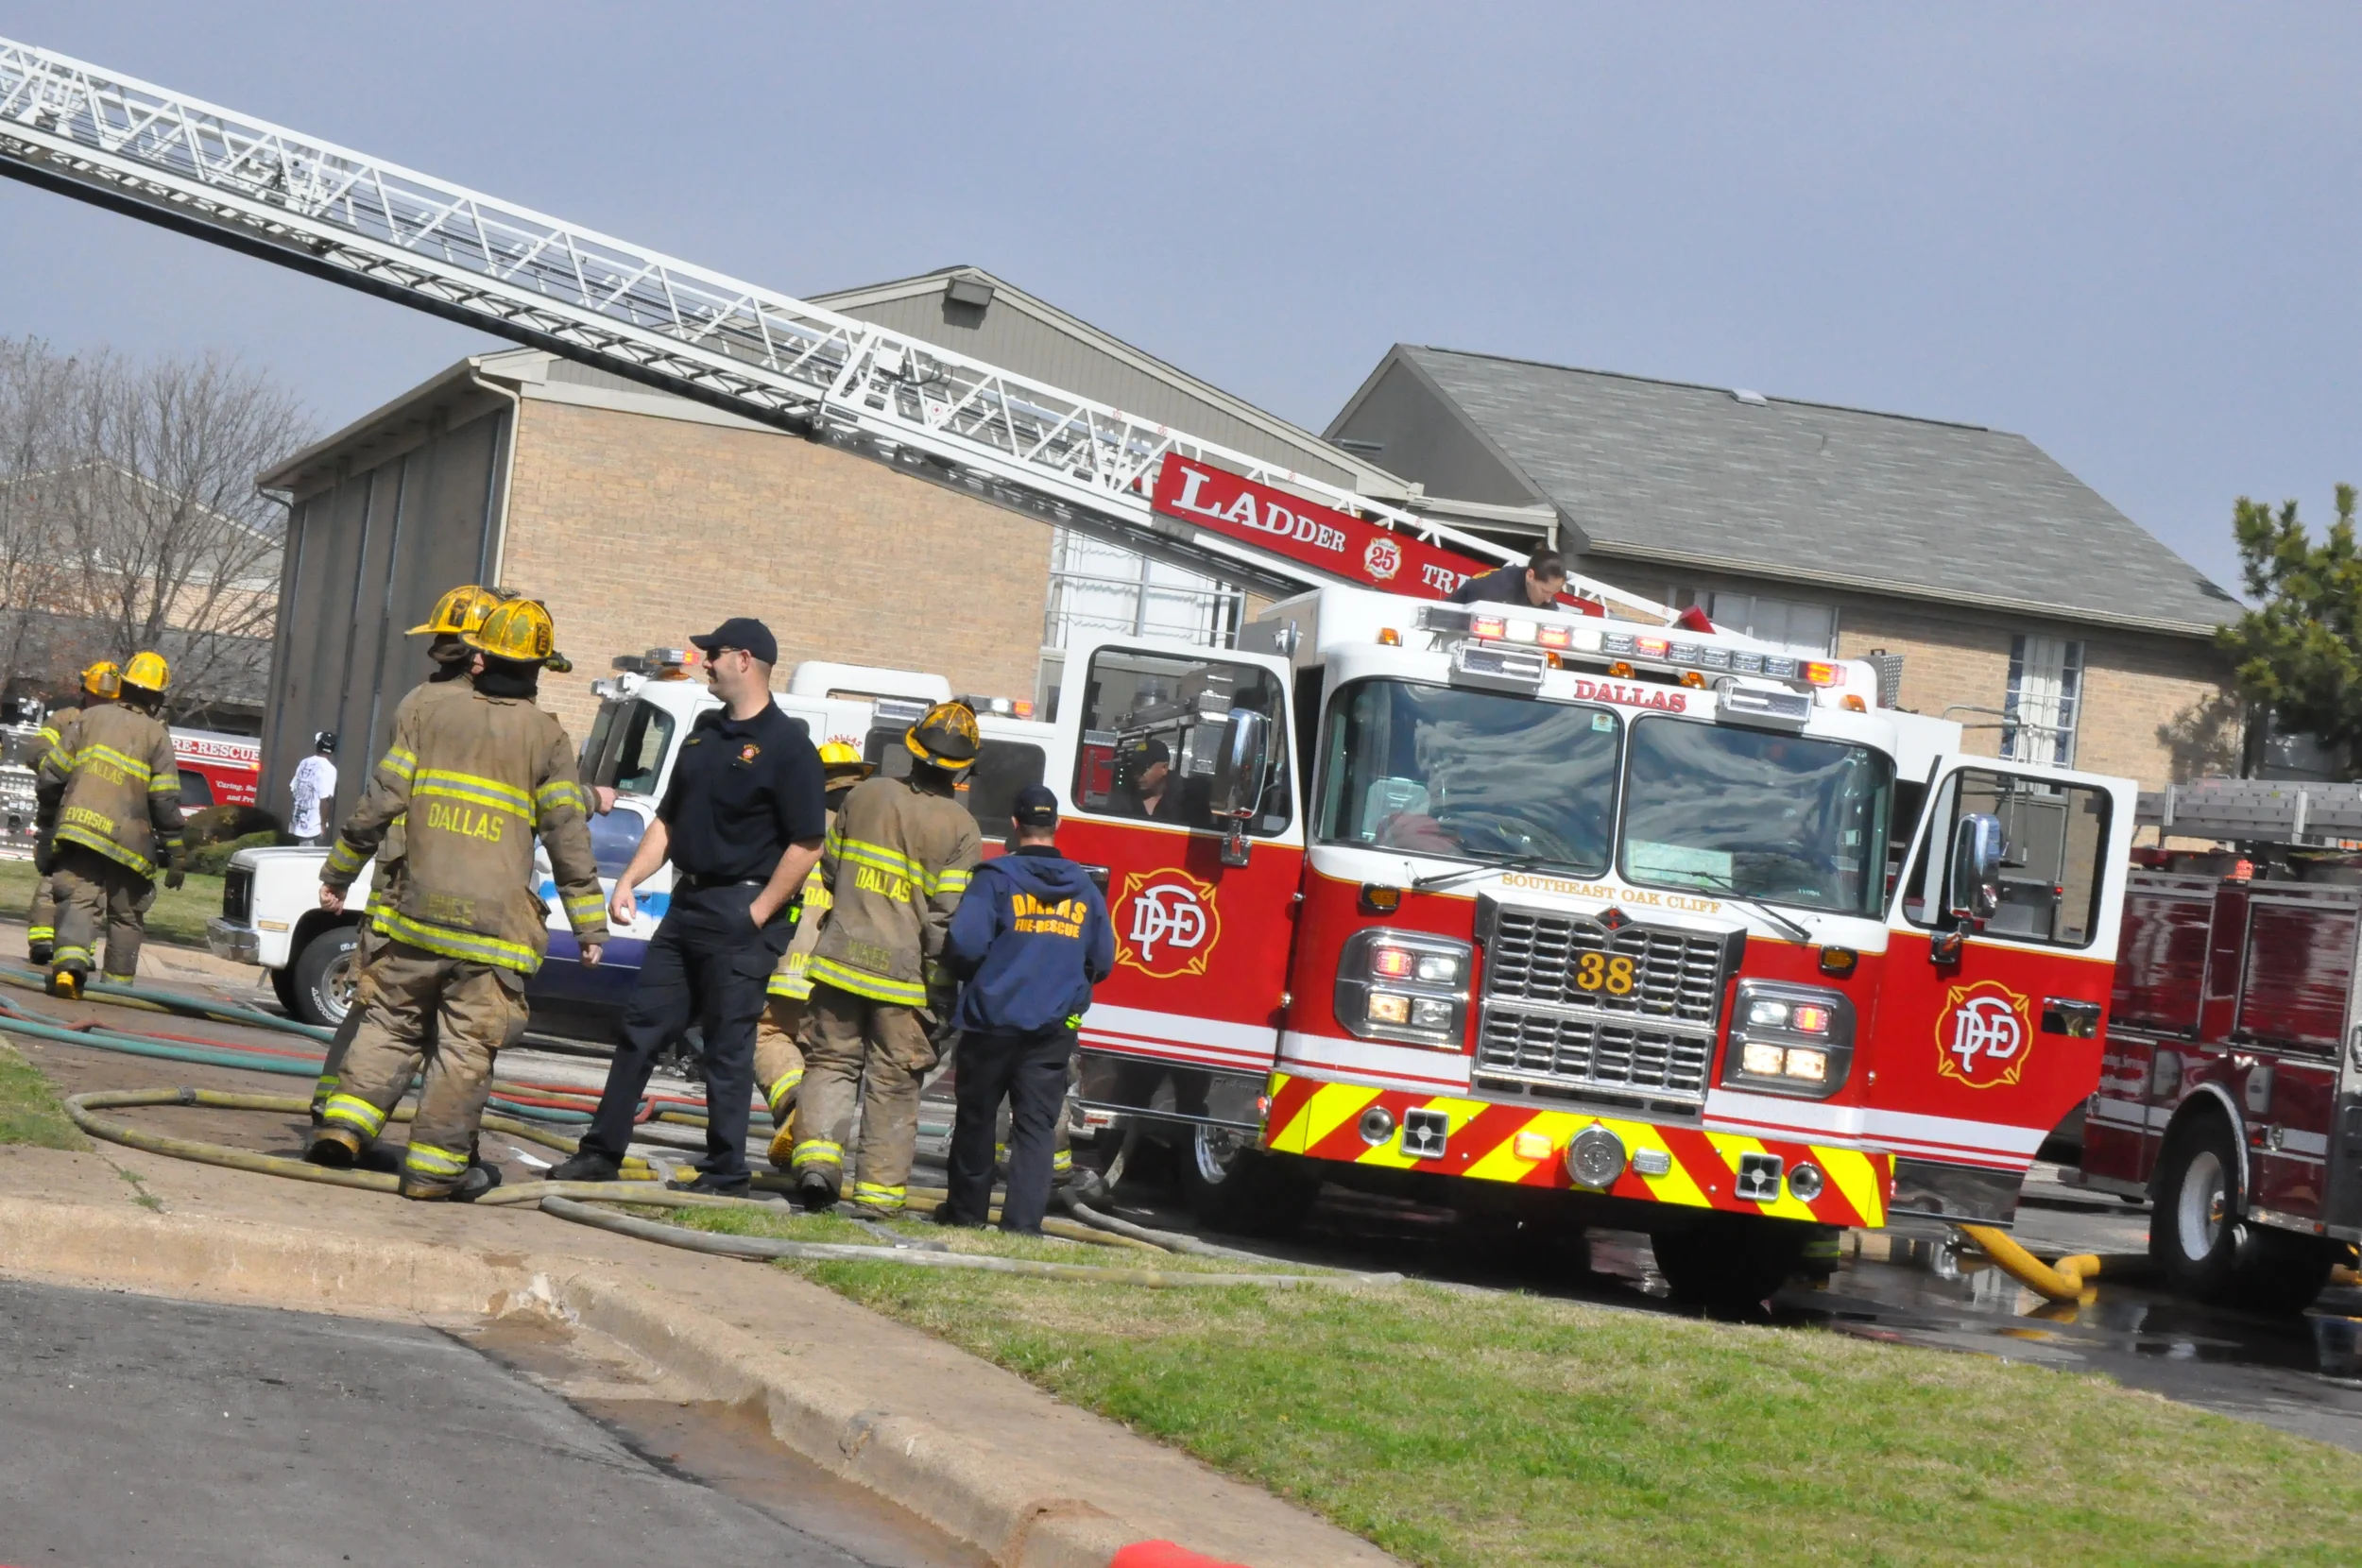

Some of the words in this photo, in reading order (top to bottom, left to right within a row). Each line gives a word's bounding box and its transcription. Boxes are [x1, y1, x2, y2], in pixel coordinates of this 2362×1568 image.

[1171, 466, 1346, 553] LADDER
[1369, 546, 1396, 571] 25
[1574, 679, 1686, 713] DALLAS
[827, 733, 863, 748] DALLAS
[84, 759, 125, 786] DALLAS
[65, 807, 114, 835] EVERSON
[428, 802, 504, 843] DALLAS
[855, 866, 911, 903] DALLAS
[1501, 872, 1616, 900] SOUTHEAST
[1621, 889, 1661, 907] OAK
[1667, 895, 1722, 914] CLIFF
[1577, 952, 1634, 995] 38
